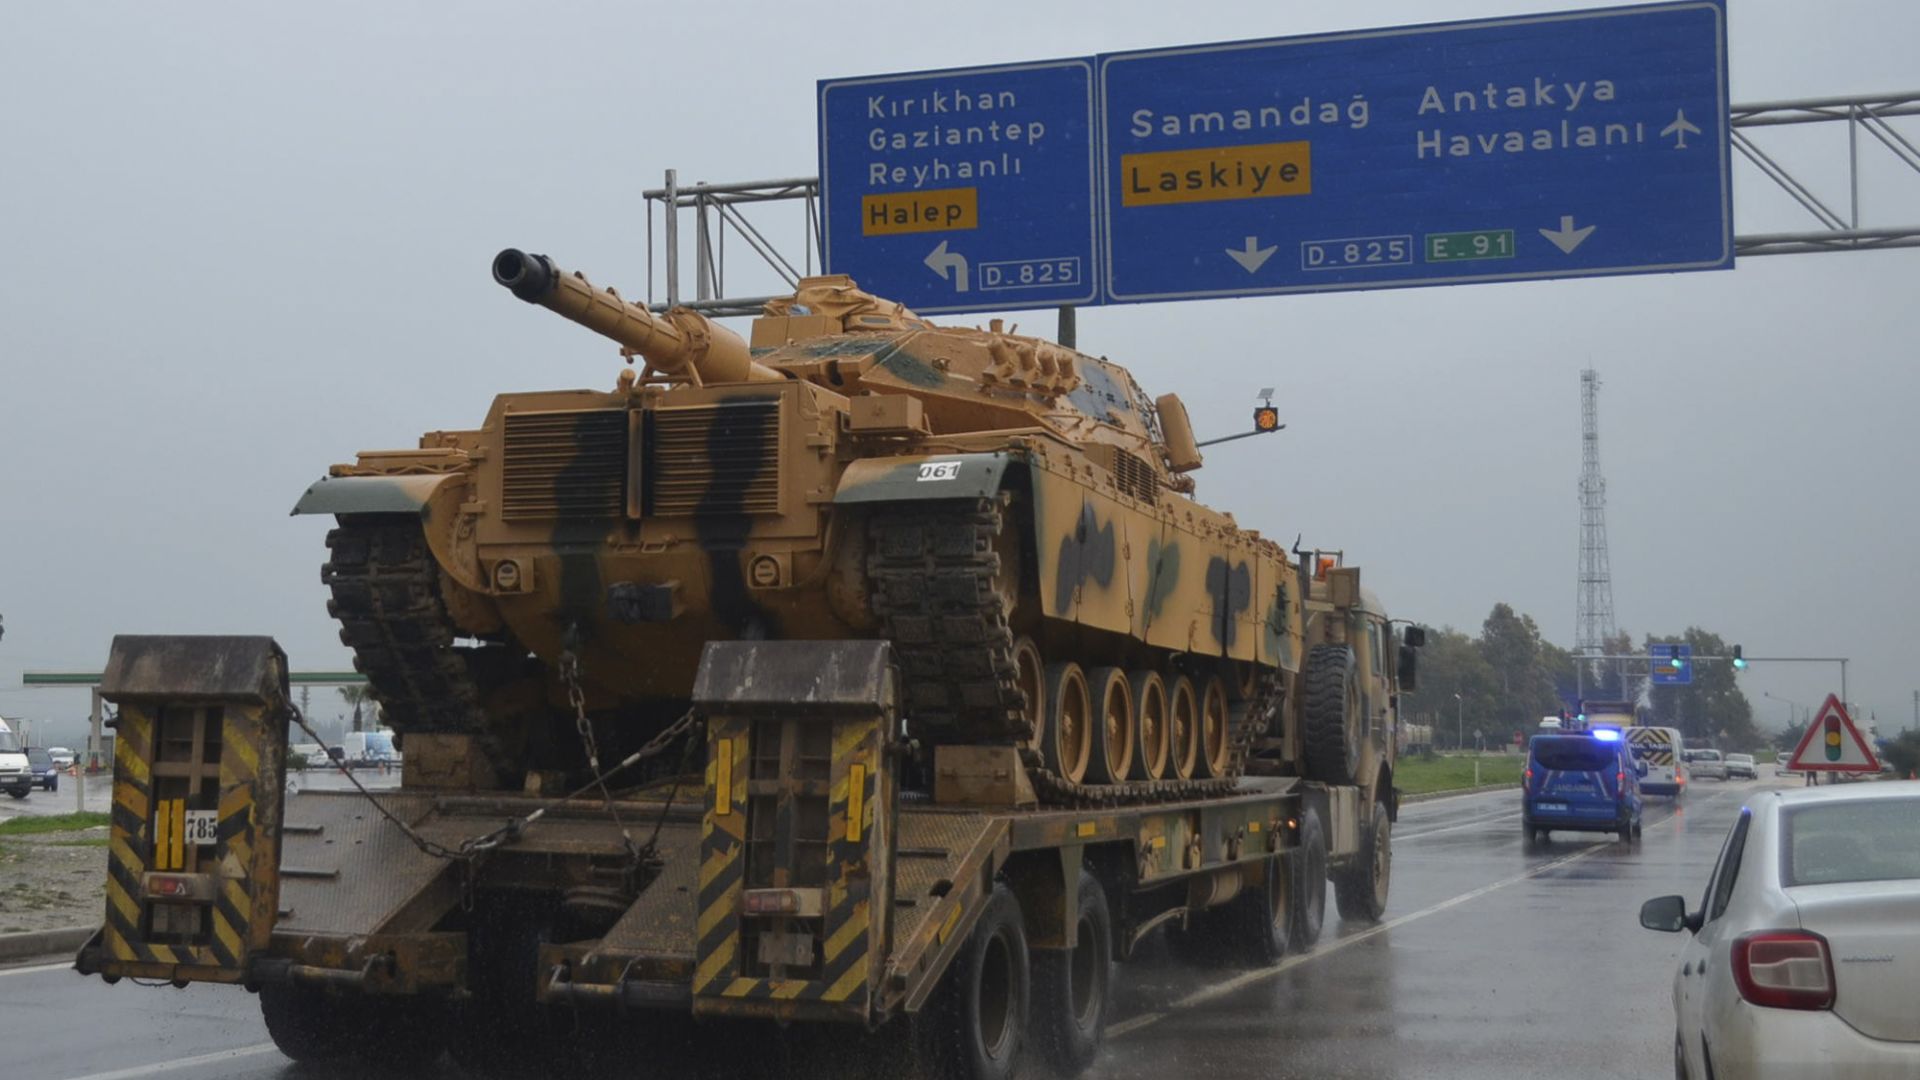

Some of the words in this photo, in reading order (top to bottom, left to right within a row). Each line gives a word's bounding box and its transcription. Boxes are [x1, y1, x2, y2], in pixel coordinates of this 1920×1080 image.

[867, 90, 1016, 119] Kırıkhan
[1418, 77, 1616, 116] Antakya
[1130, 94, 1370, 138] Samandağ
[868, 121, 1045, 151] Gaziantep
[1416, 119, 1644, 159] Havaalanı
[869, 153, 1021, 188] Reyhanlı
[1132, 161, 1300, 194] Laskiye
[870, 201, 963, 227] Halep
[919, 464, 960, 479] 061
[187, 817, 217, 839] 785
